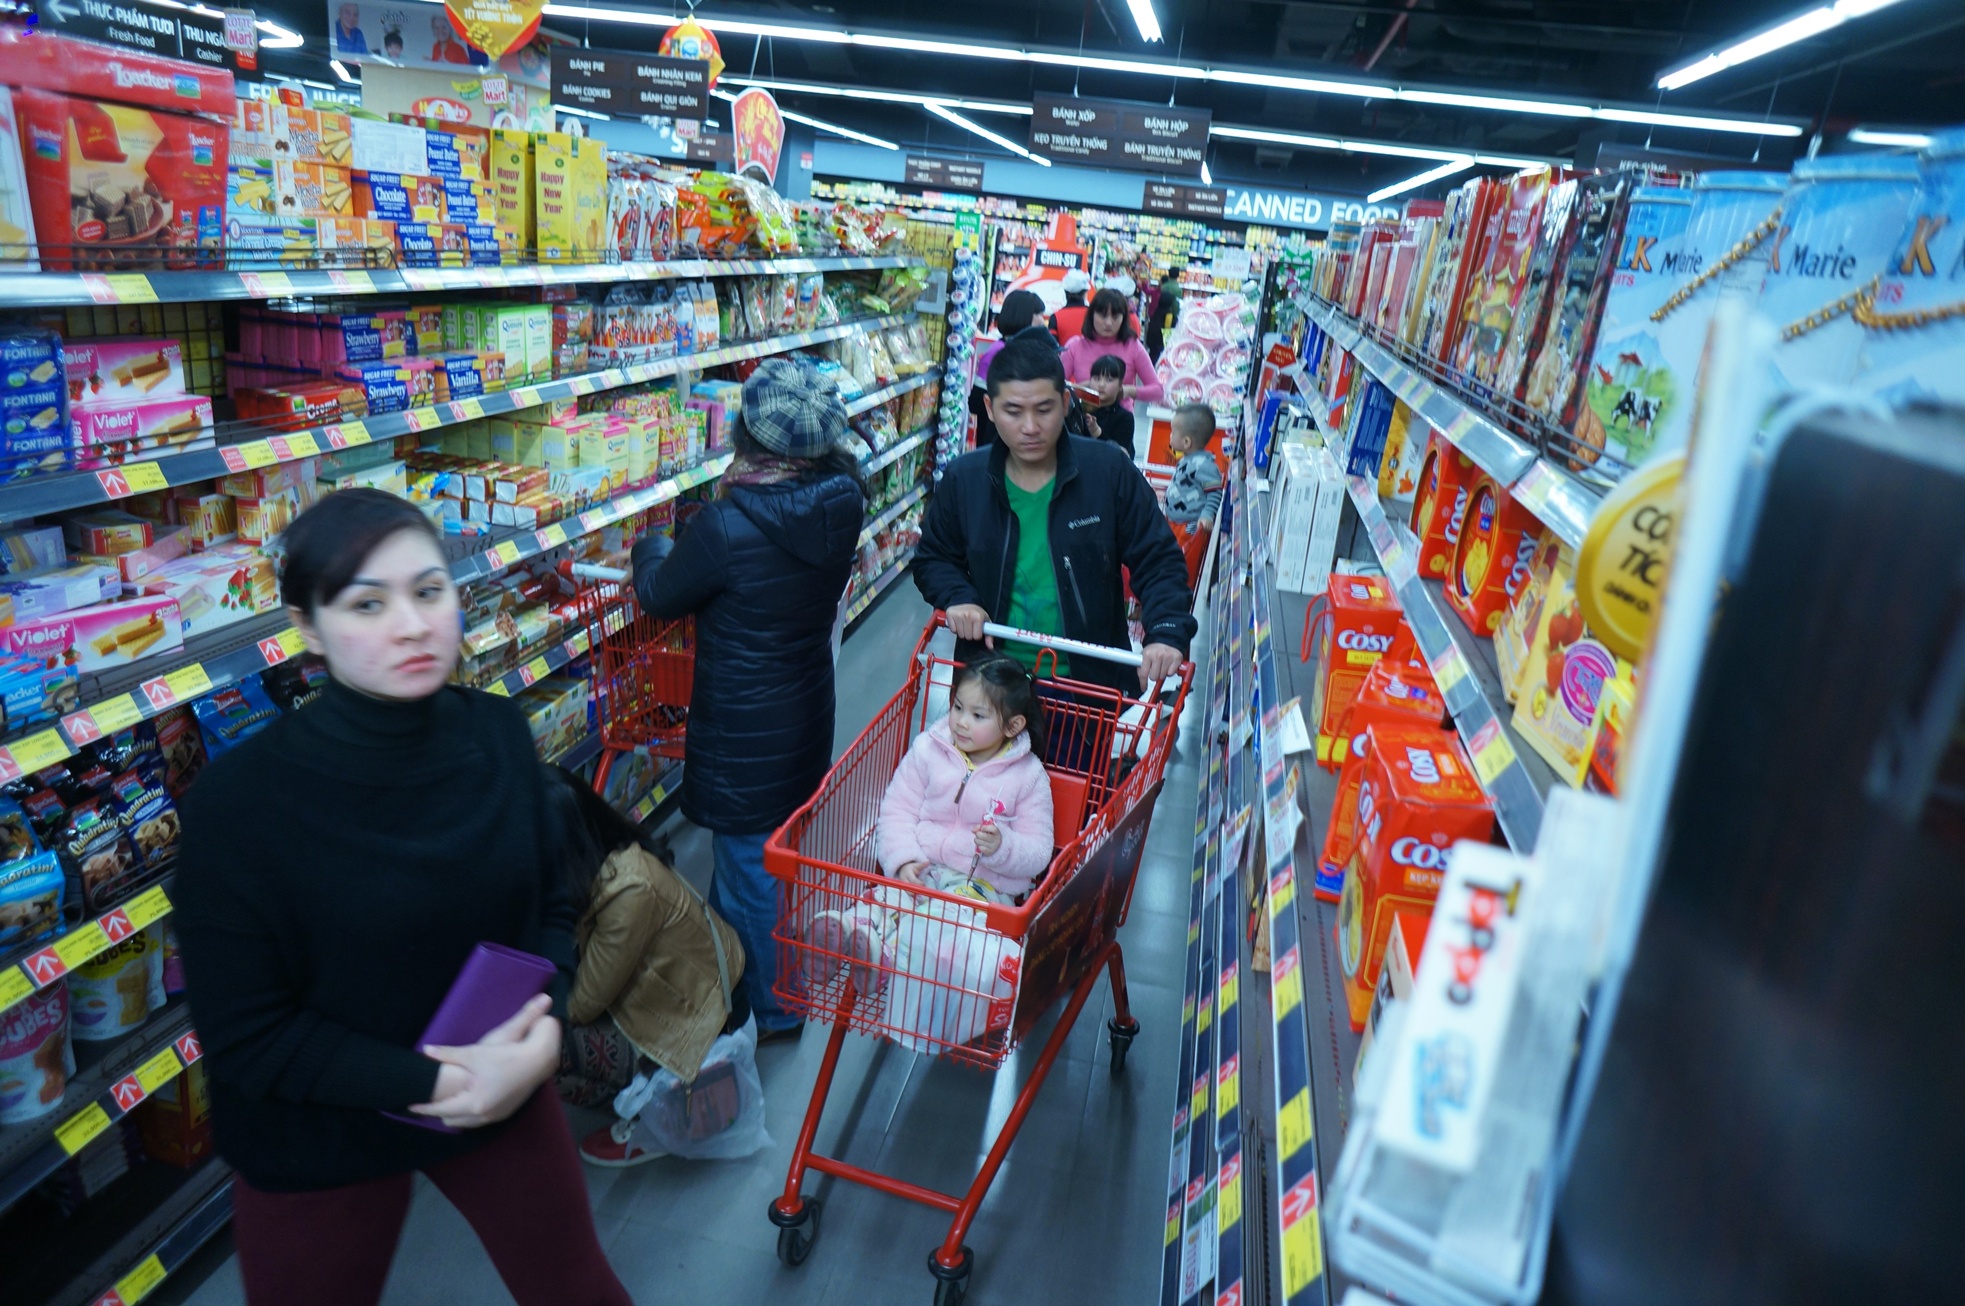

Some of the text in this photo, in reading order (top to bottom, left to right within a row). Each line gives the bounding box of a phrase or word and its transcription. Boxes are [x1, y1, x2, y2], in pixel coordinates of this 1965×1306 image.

[109, 27, 156, 48] Fresh Food
[184, 24, 226, 48] THU NGÂ
[229, 30, 255, 46] Mart
[196, 48, 224, 64] Cashier
[570, 58, 605, 73] BÁNH PIE
[637, 66, 661, 79] BÁNH
[685, 71, 703, 83] KEM
[485, 91, 506, 103] Mart
[562, 84, 612, 99] BÁNH COOKIES
[640, 92, 663, 104] BÁNH
[1052, 106, 1077, 119] BÁNH
[1144, 117, 1189, 133] BÁNH HỘP
[427, 132, 439, 142] SUGAR
[1034, 132, 1050, 146] KẸO
[428, 147, 444, 160] Peanut
[1124, 142, 1146, 154] BÁNH
[370, 172, 386, 183] SUGAR
[497, 167, 520, 181] Happy
[540, 172, 564, 186] Happy
[374, 186, 407, 203] Chocolate
[447, 194, 461, 206] Peanut
[499, 199, 518, 210] Year
[543, 203, 563, 214] Year
[404, 237, 433, 250] Chocolate
[1040, 251, 1077, 268] CHIN-SU
[1786, 242, 1858, 281] Marie
[342, 318, 356, 326] SUGAR
[346, 330, 380, 349] Strawberry
[63, 348, 93, 365] olet
[447, 361, 460, 369] SUGAR
[364, 370, 380, 380] SUGAR
[450, 371, 479, 388] Vanilla
[4, 391, 56, 407] FONTANA
[368, 382, 406, 400] Strawberry
[94, 410, 133, 430] Violet
[13, 435, 63, 452] FONTANA
[1074, 515, 1101, 528] Columbia
[1504, 530, 1540, 598] COSY
[12, 626, 67, 647] Violet
[1337, 628, 1394, 653] COSY
[5, 683, 42, 704] acker
[119, 785, 165, 826] Quadratini
[68, 816, 120, 857] Quadratini
[1390, 836, 1452, 871] COS
[0, 862, 56, 888] adratini
